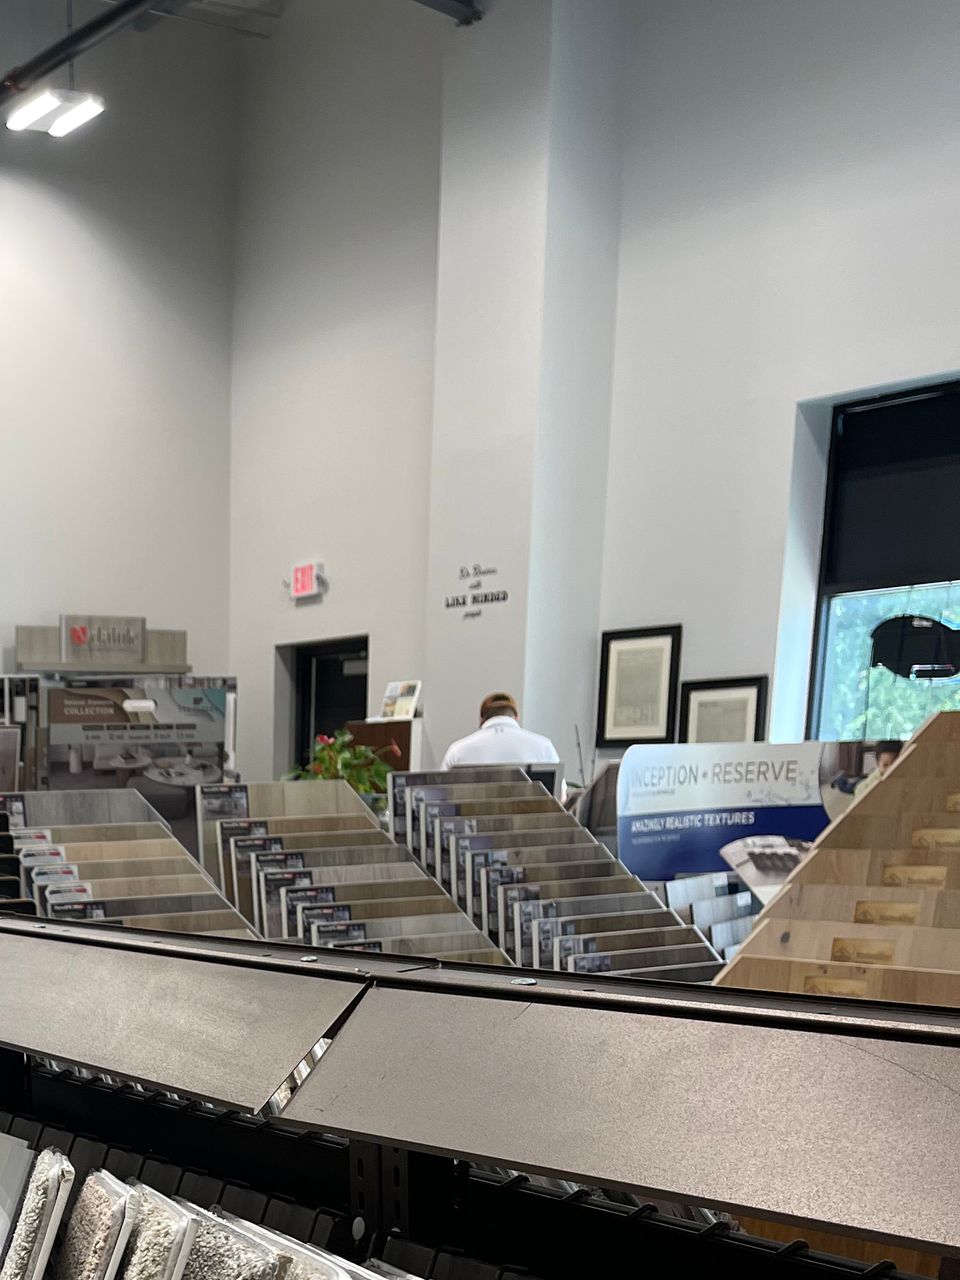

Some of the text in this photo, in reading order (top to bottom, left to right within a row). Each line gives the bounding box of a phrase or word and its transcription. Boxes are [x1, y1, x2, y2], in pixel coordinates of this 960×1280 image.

[293, 565, 314, 594] EXIT
[445, 590, 509, 608] LIKE MINDED
[632, 760, 798, 789] INCEPTION RESERVE
[632, 811, 755, 833] AMAZINGLY REALISTIC TEXTURES
